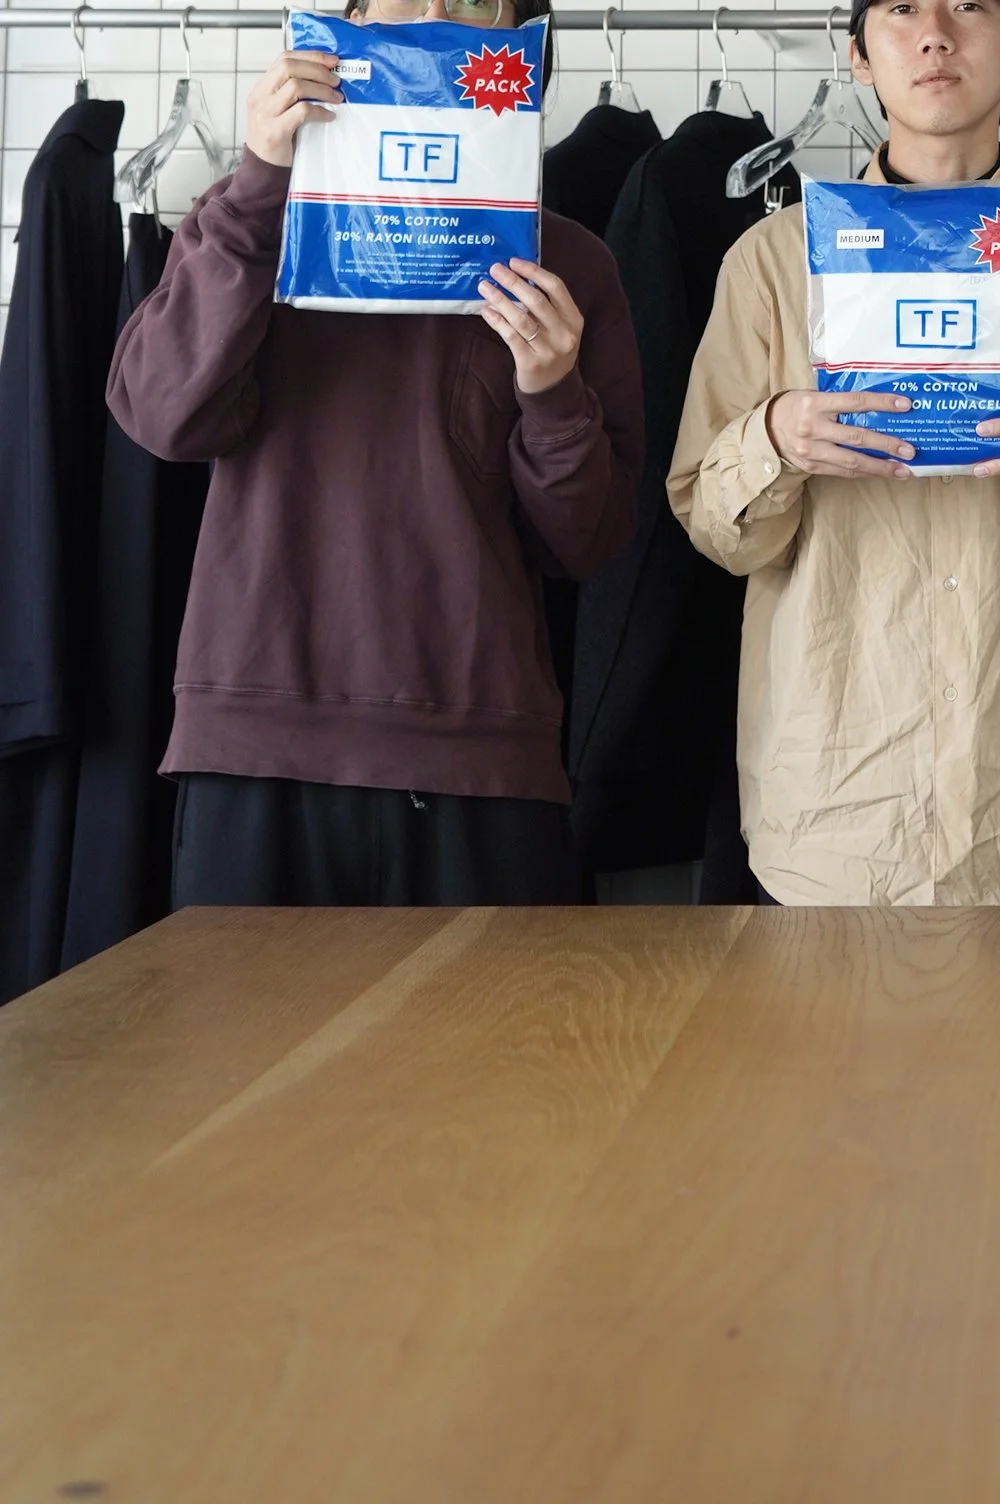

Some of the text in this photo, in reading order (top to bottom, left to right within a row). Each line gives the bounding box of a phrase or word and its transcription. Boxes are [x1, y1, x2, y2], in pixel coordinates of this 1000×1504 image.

[493, 61, 503, 75] 2
[474, 79, 521, 93] PACK
[397, 143, 441, 172] TF
[374, 215, 460, 227] 70% COTTON
[334, 231, 361, 242] 30%
[366, 233, 413, 244] RAYON
[839, 235, 881, 243] MEDIUM
[914, 311, 959, 338] TF
[892, 382, 978, 392] 70% COTTON
